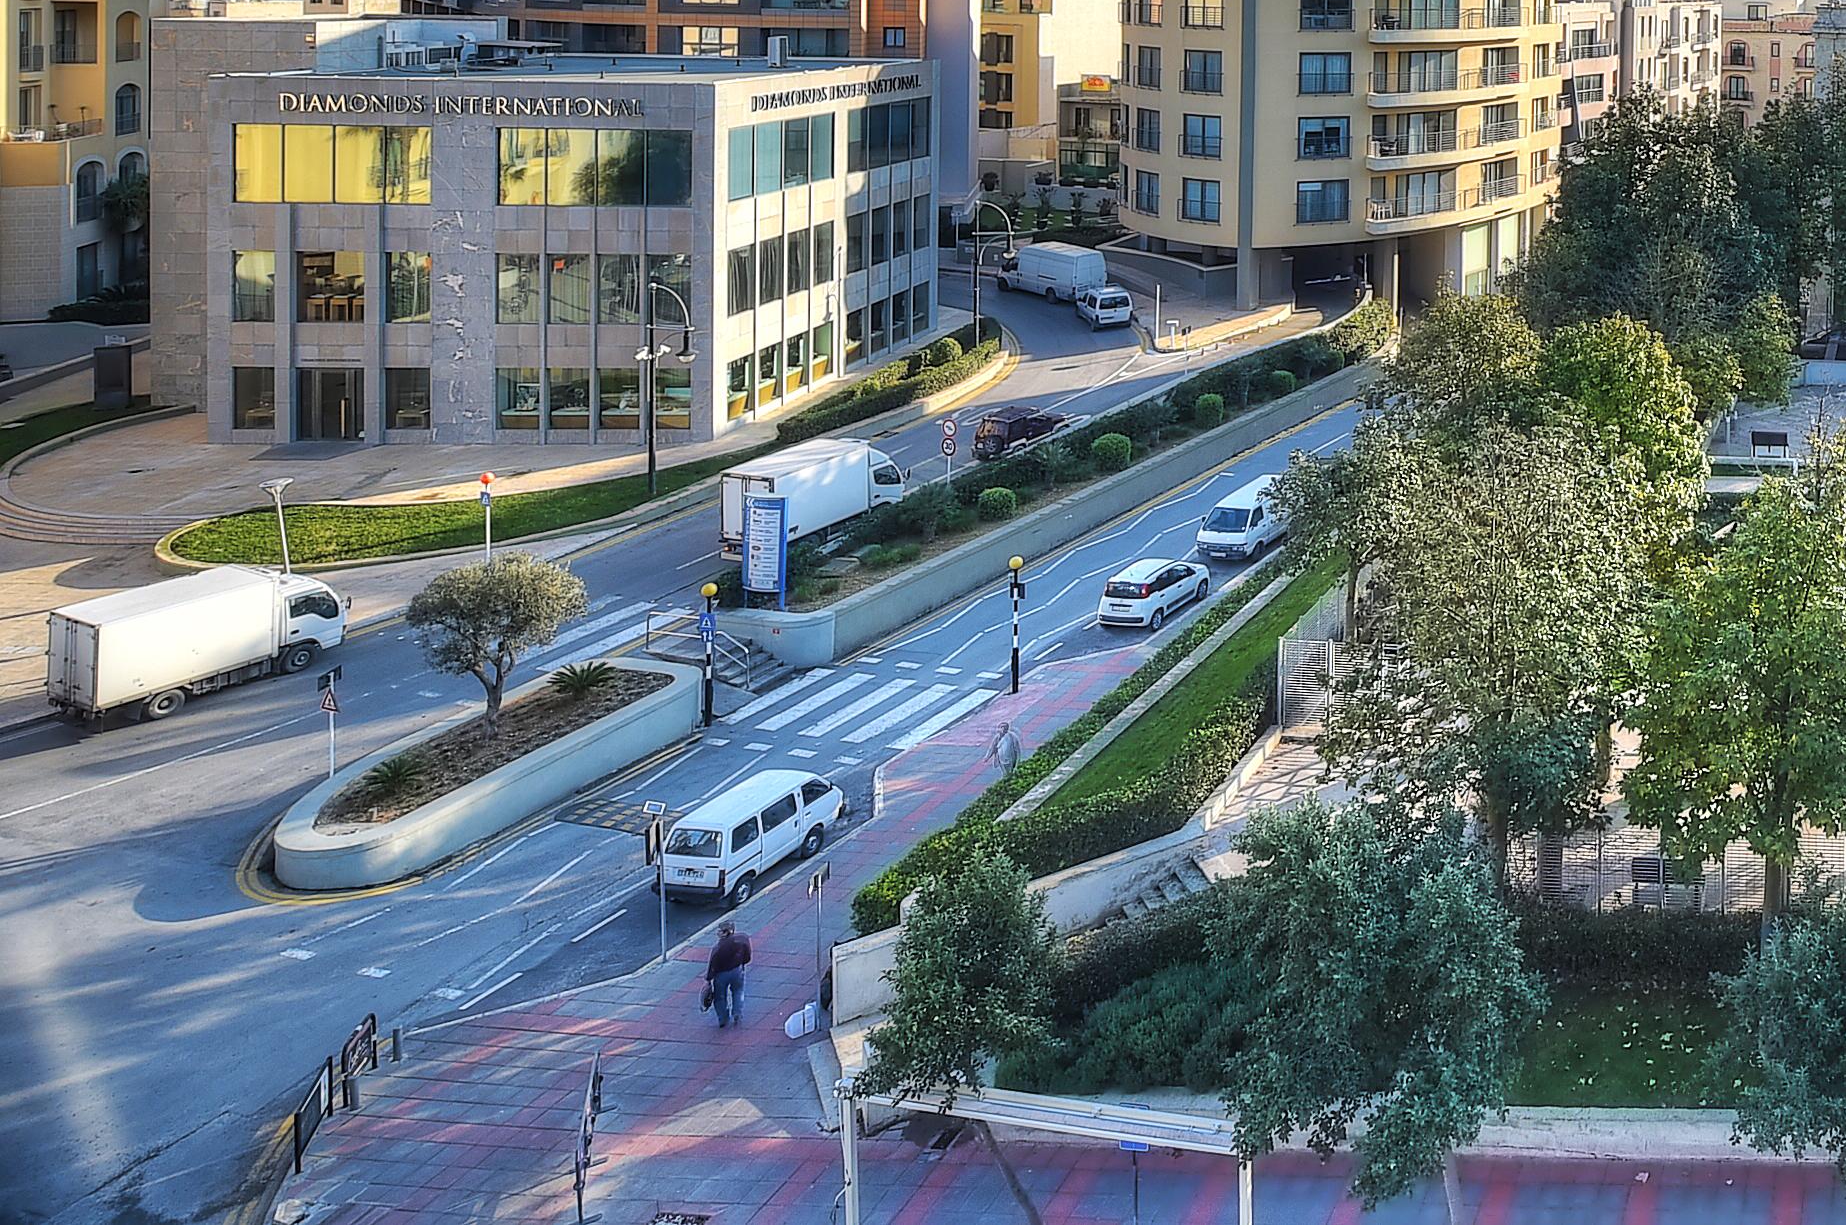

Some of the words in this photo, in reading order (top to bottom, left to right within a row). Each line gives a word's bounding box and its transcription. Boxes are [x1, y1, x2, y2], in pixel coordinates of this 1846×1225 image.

[829, 74, 922, 100] INTERNATIONAL
[279, 92, 425, 114] DIAMONDS
[434, 95, 645, 117] INTERNATIONAL
[945, 441, 953, 451] 30
